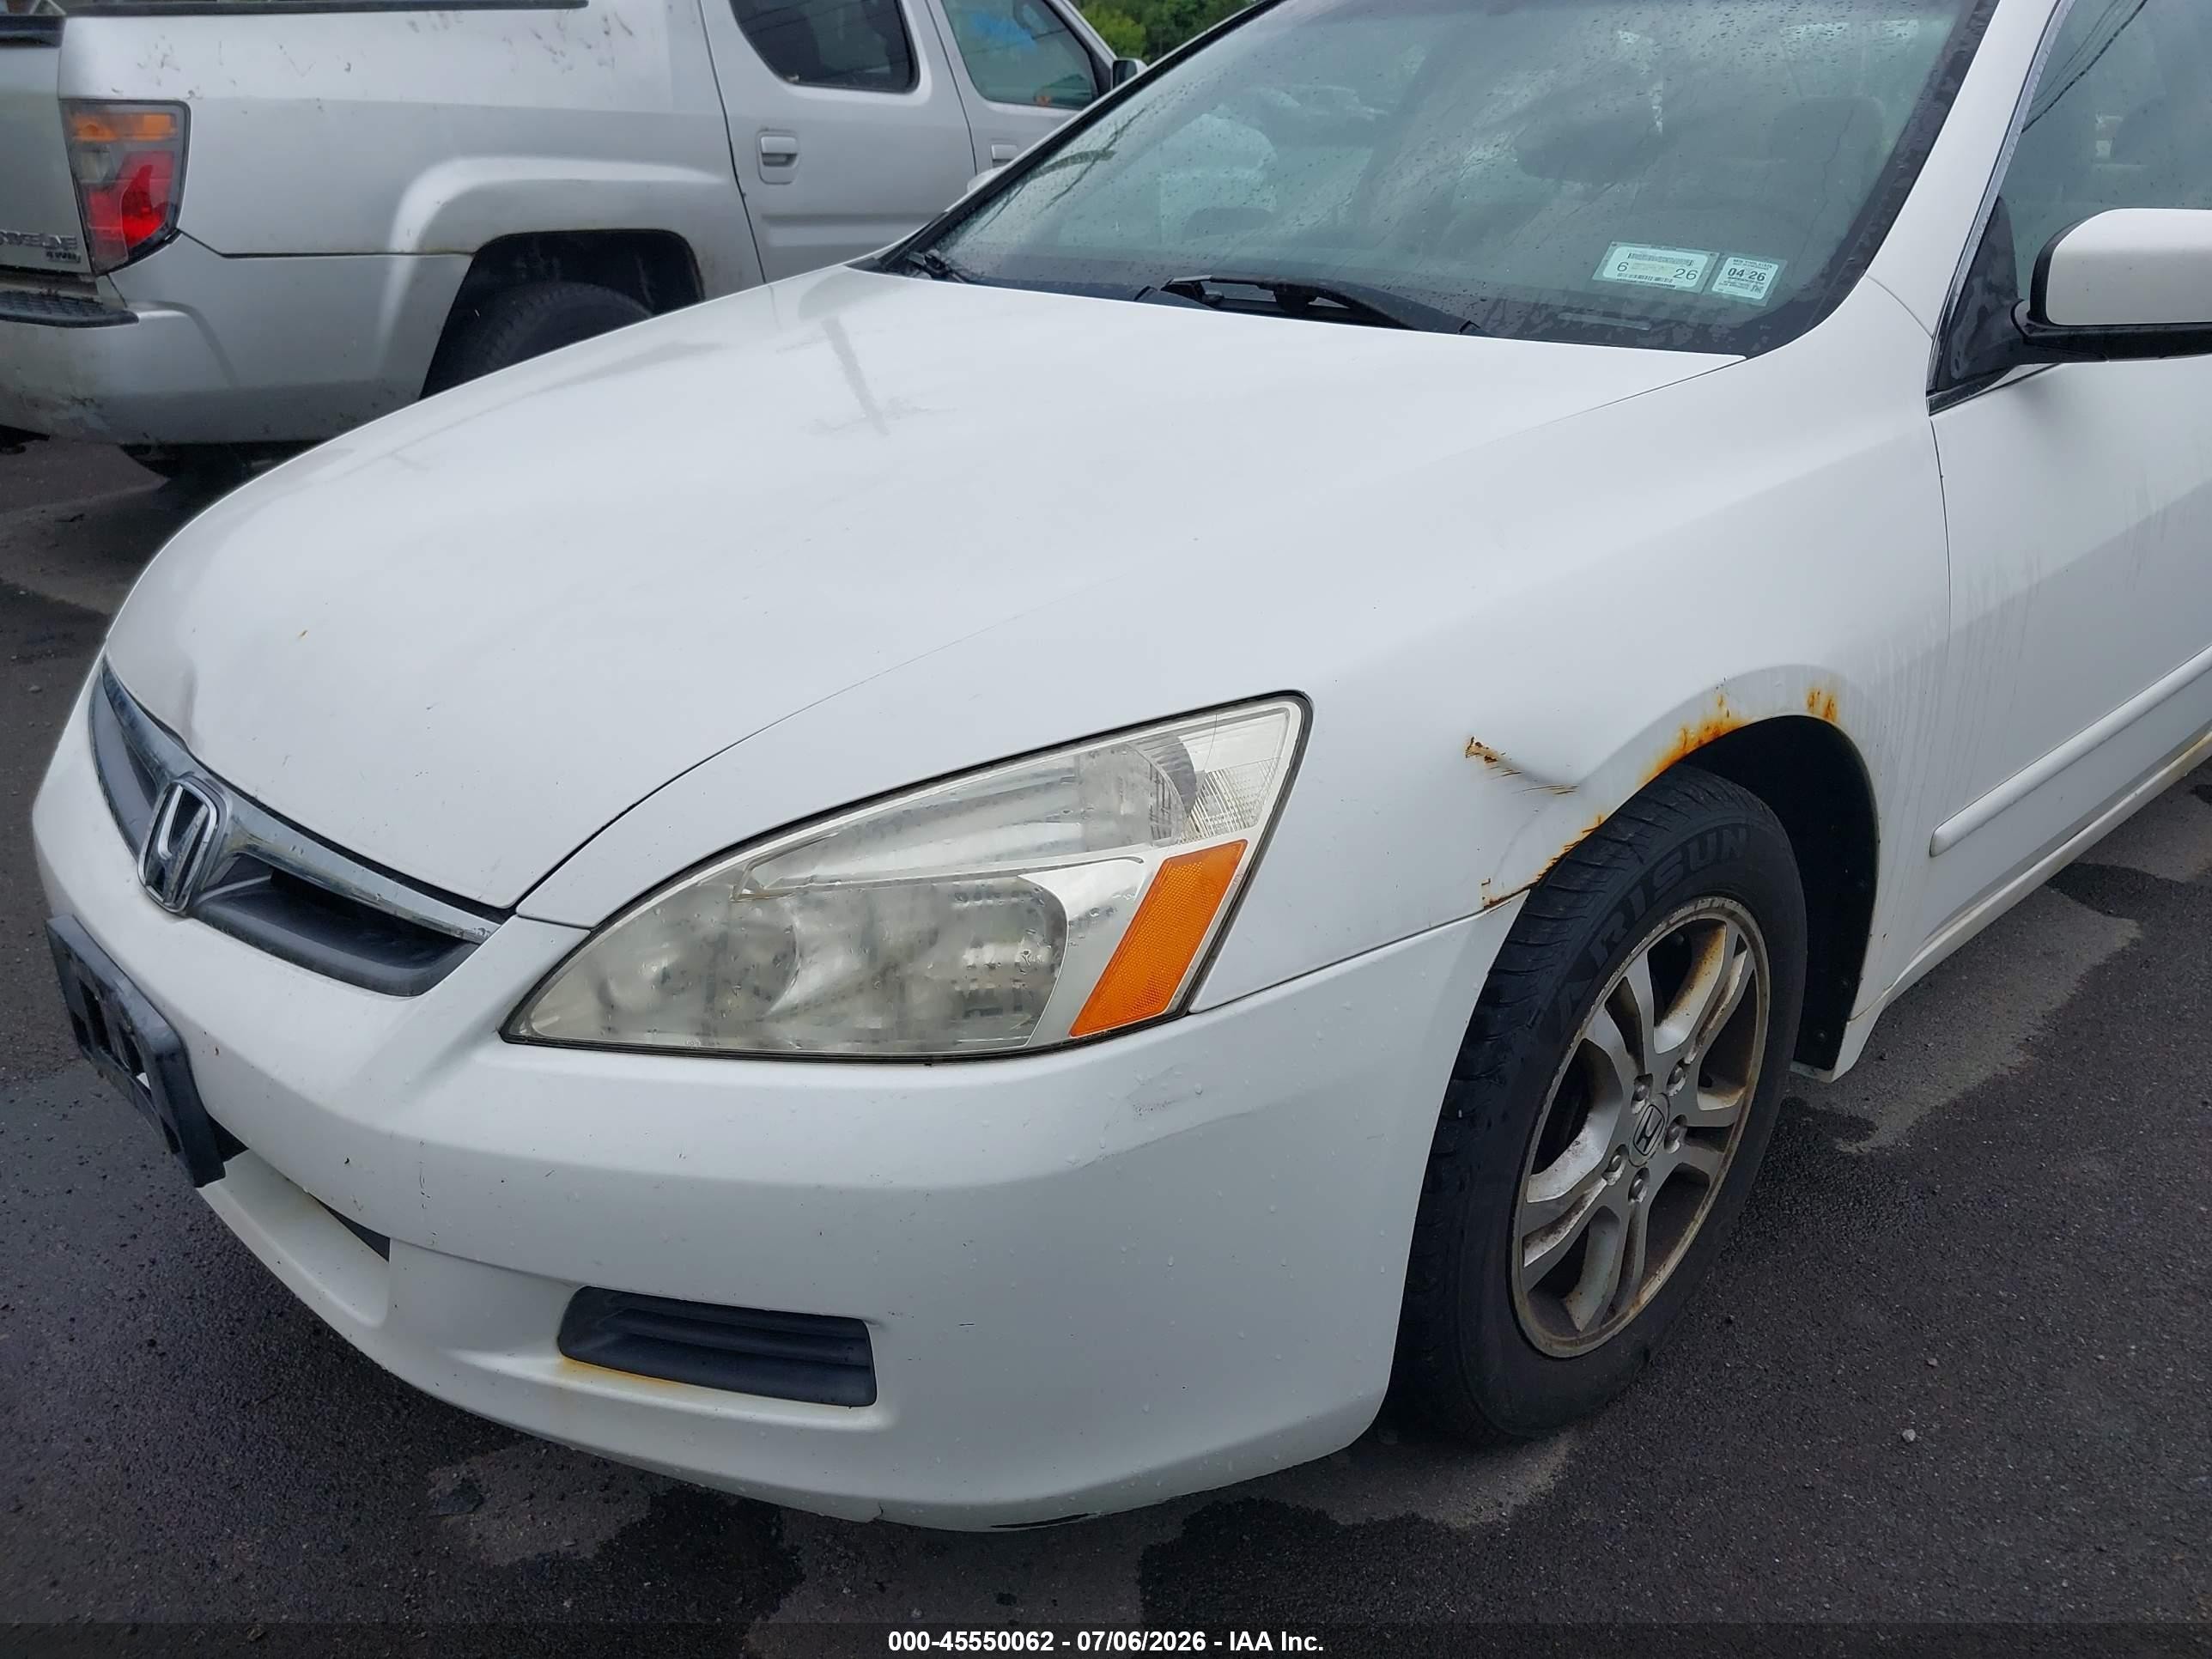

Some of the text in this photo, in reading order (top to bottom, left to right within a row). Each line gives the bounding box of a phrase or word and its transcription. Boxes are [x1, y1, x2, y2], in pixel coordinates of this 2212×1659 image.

[1616, 261, 1629, 272] 6
[1673, 268, 1698, 281] 26
[1728, 267, 1745, 277] 04
[1748, 270, 1766, 282] 26
